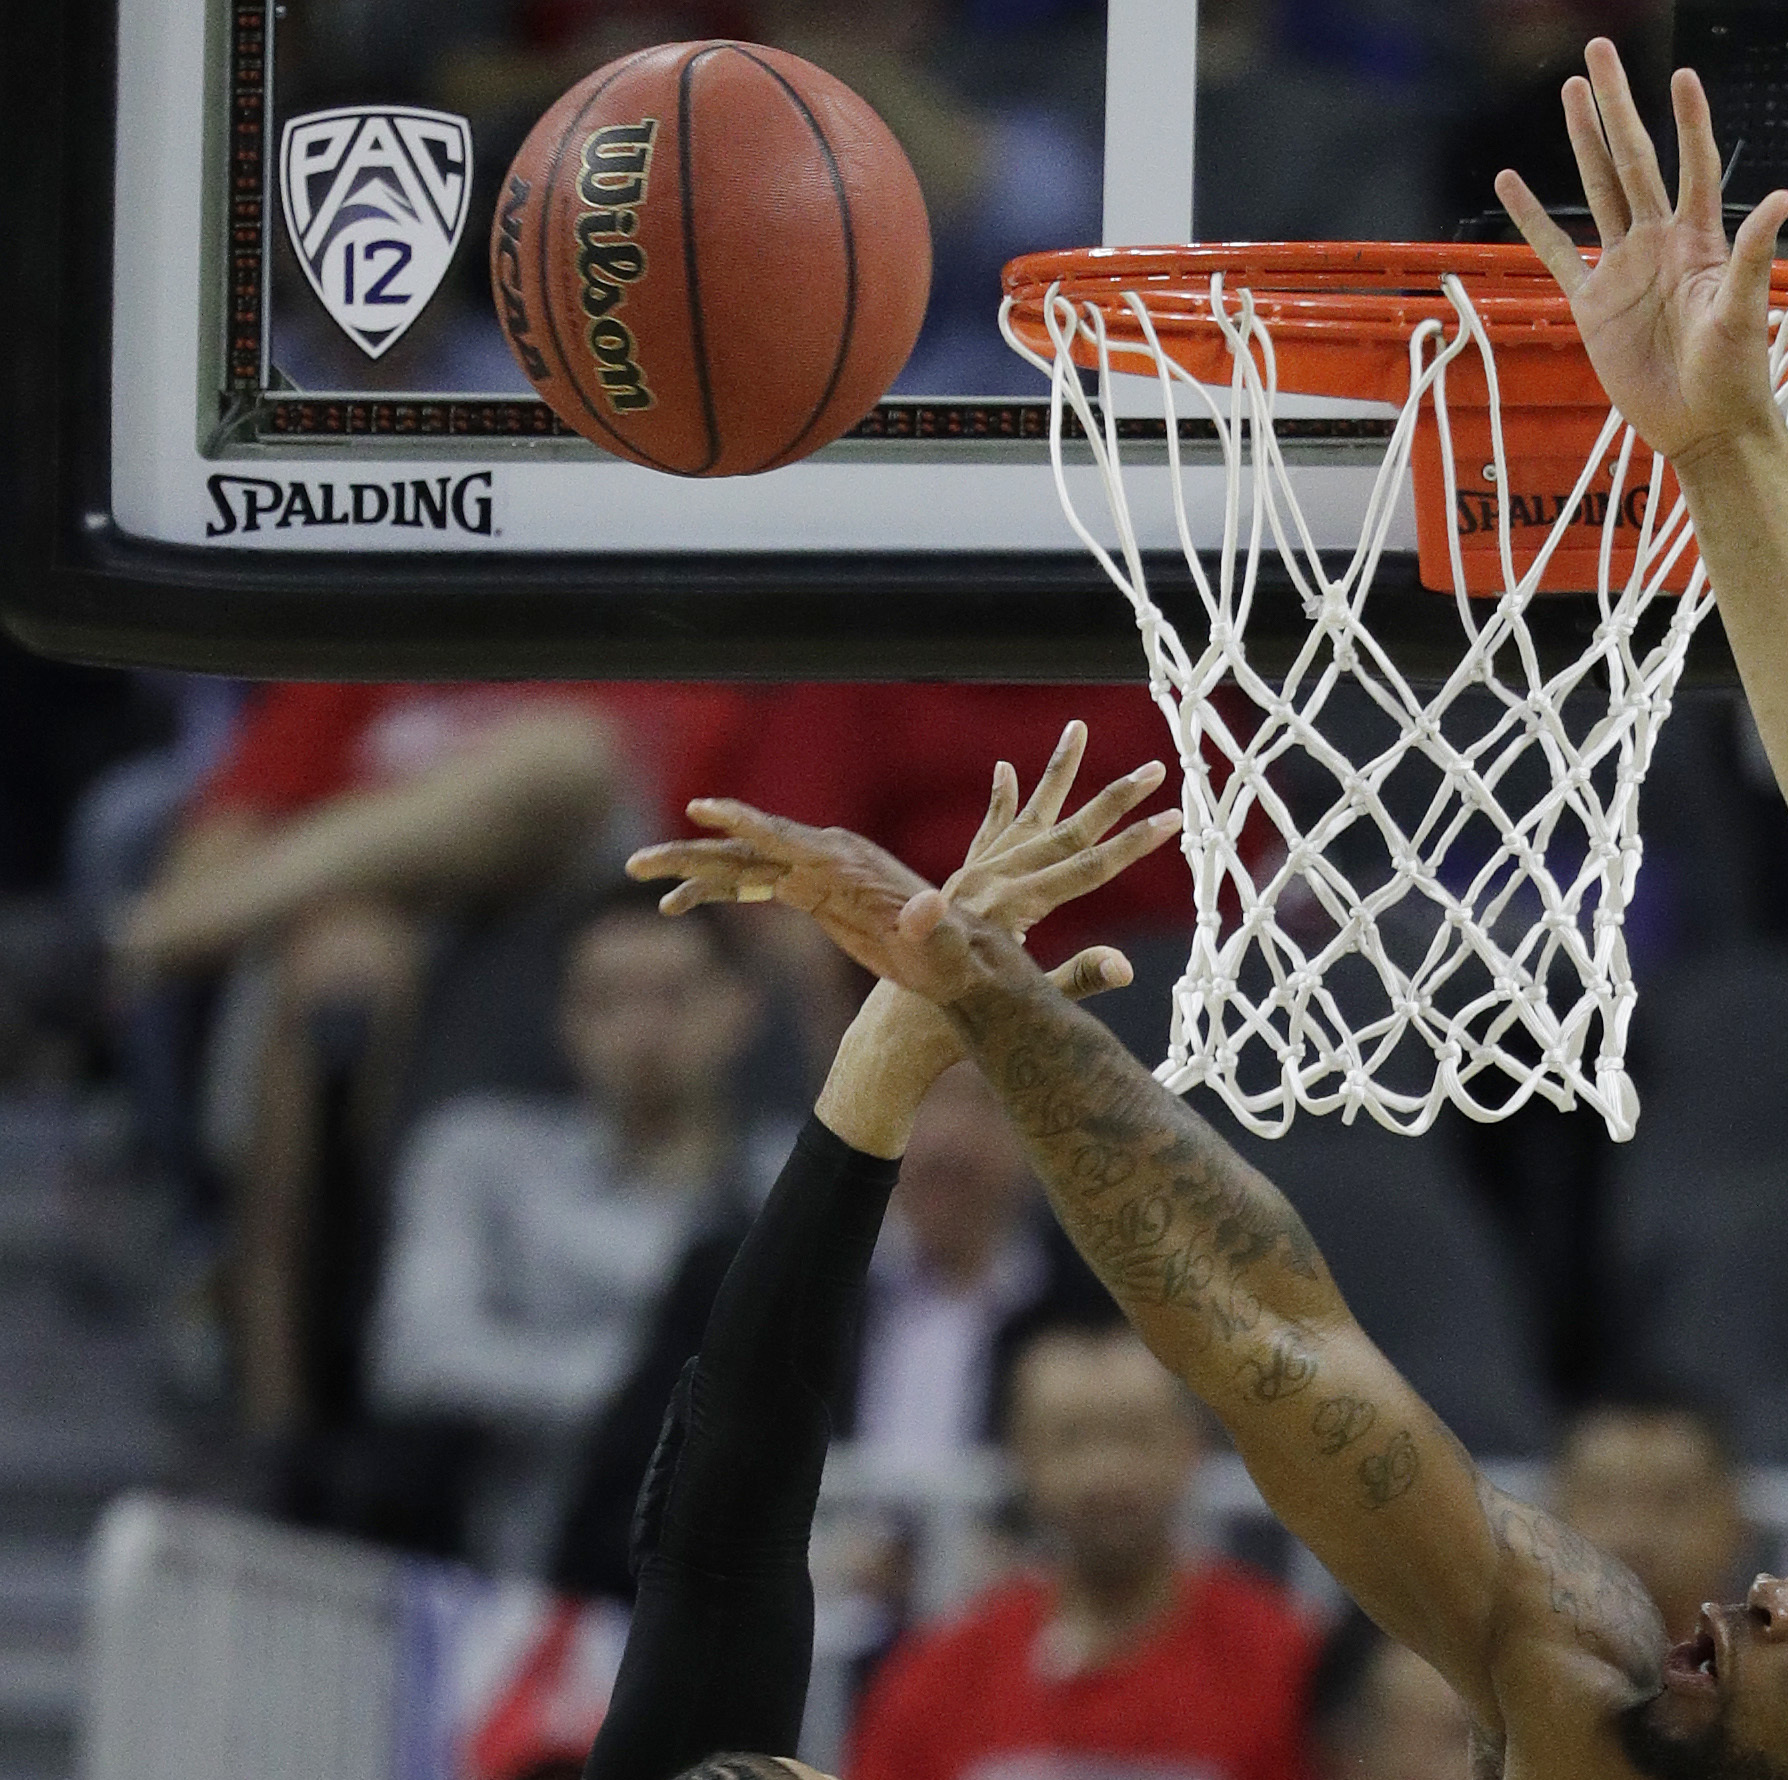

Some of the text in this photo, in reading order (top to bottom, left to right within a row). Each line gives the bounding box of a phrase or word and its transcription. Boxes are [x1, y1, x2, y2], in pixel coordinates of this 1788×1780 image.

[292, 117, 464, 262] PAC
[344, 239, 413, 305] 12
[500, 174, 550, 382] NCAA
[575, 117, 658, 415] Wilson
[206, 471, 494, 537] SPALDING
